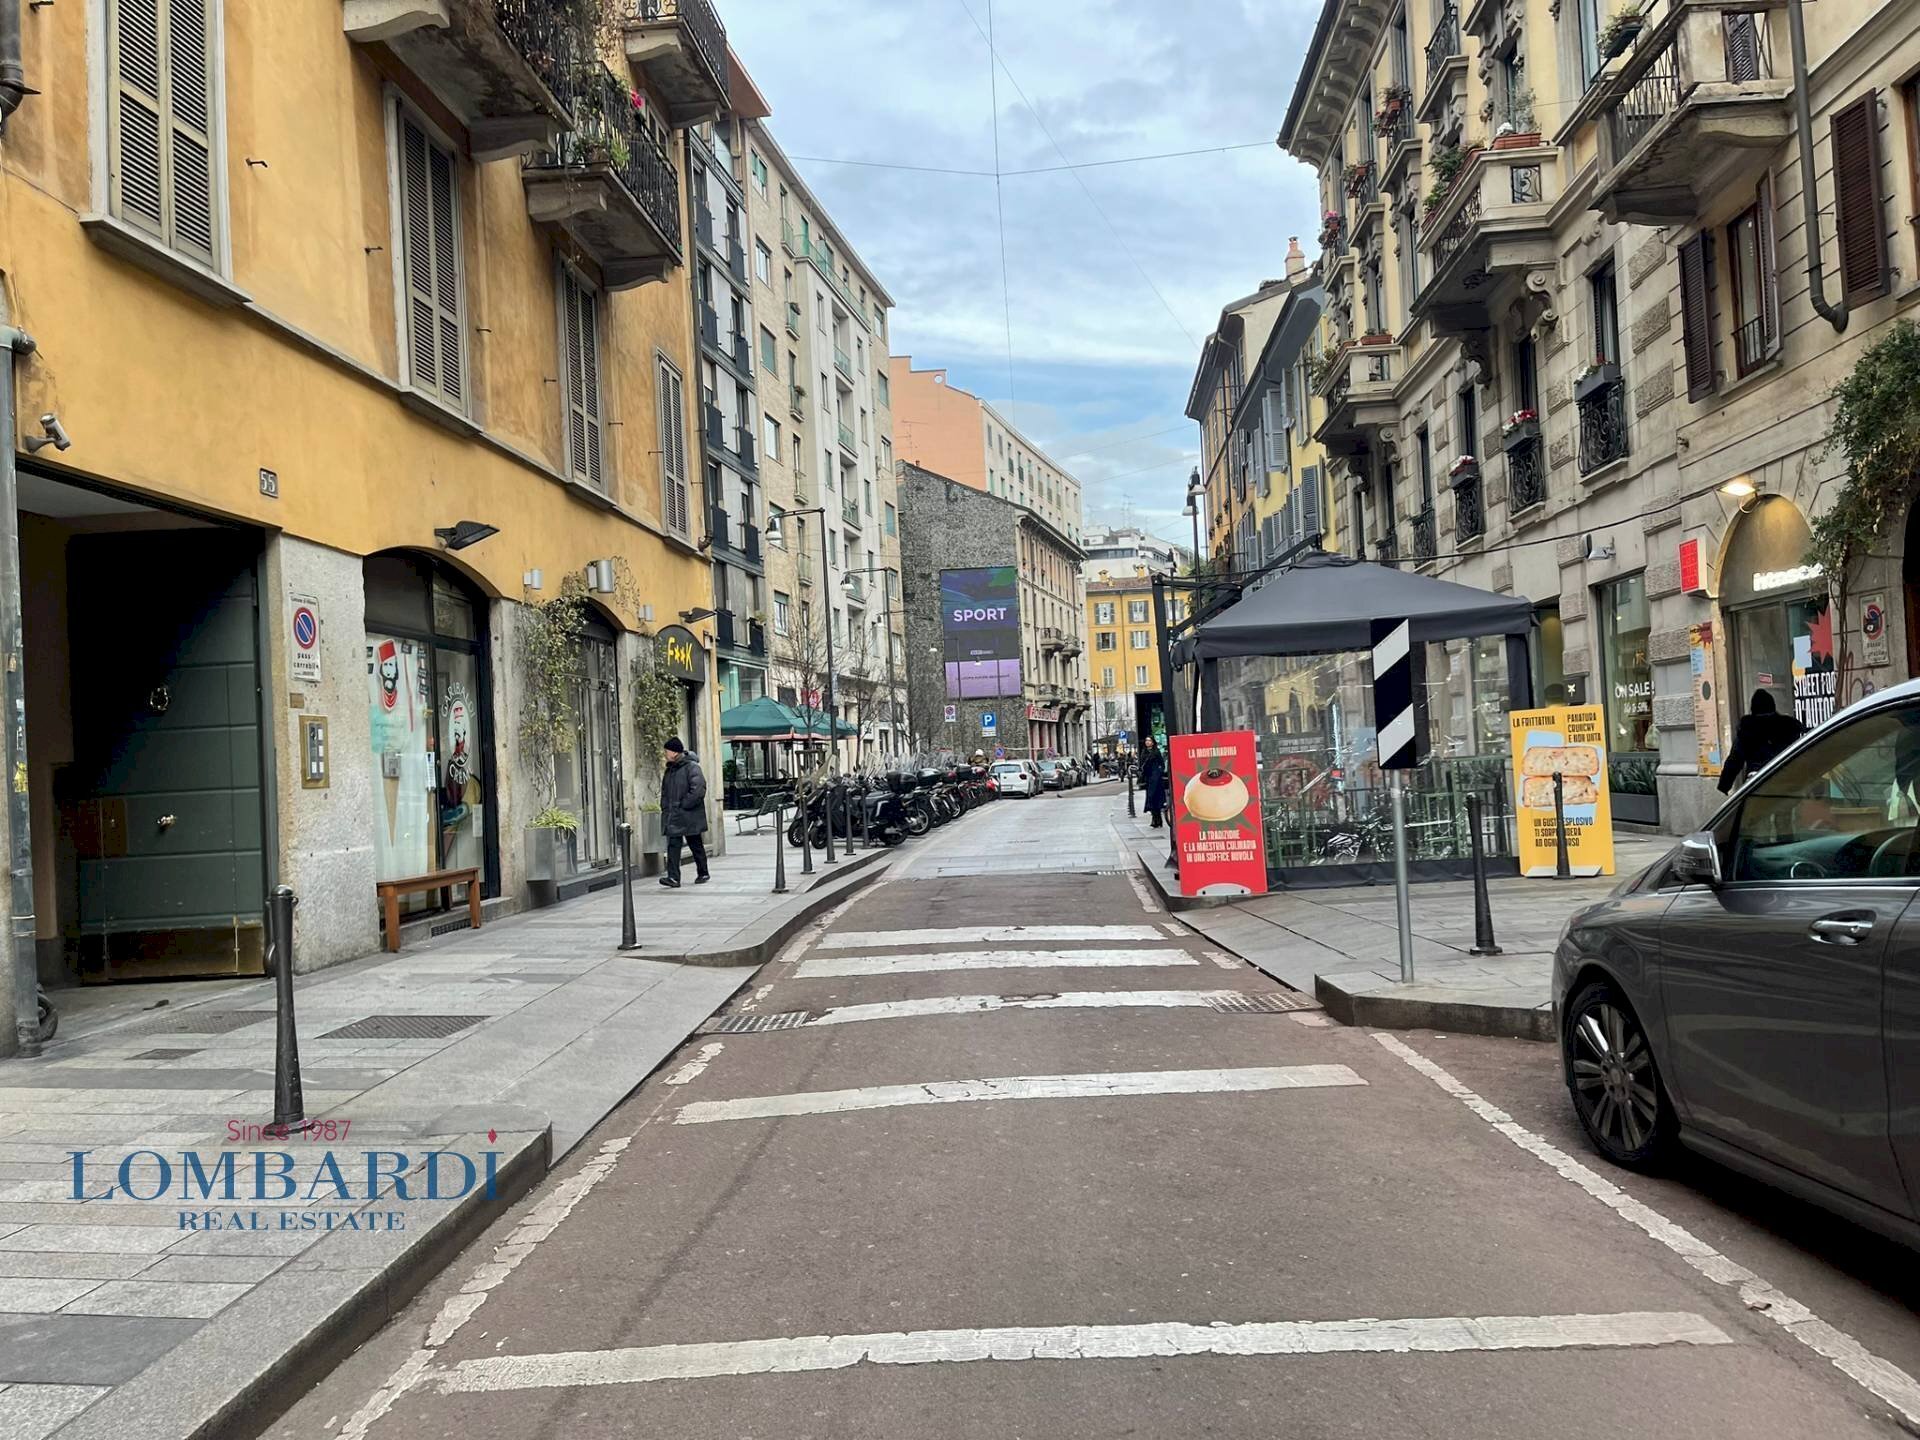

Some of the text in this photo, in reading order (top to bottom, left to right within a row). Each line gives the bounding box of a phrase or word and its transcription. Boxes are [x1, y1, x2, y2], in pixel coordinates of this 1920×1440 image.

[260, 470, 277, 493] 55
[953, 607, 1007, 622] SPORT
[1793, 672, 1820, 698] STREET
[1614, 685, 1628, 698] ON
[441, 681, 477, 719] GARIBALDI
[984, 714, 993, 726] P
[1512, 718, 1520, 728] LA
[1567, 712, 1597, 723] PANATURA
[1567, 723, 1595, 733] CRUNCHY
[1568, 734, 1573, 743] E
[1187, 748, 1196, 759] LA
[1542, 817, 1557, 827] GUST
[1198, 829, 1241, 841] LA TRADIZIONE
[1534, 828, 1540, 837] TI
[1183, 842, 1188, 852] E
[1188, 842, 1196, 852] LA
[1206, 851, 1230, 862] SOFFICE
